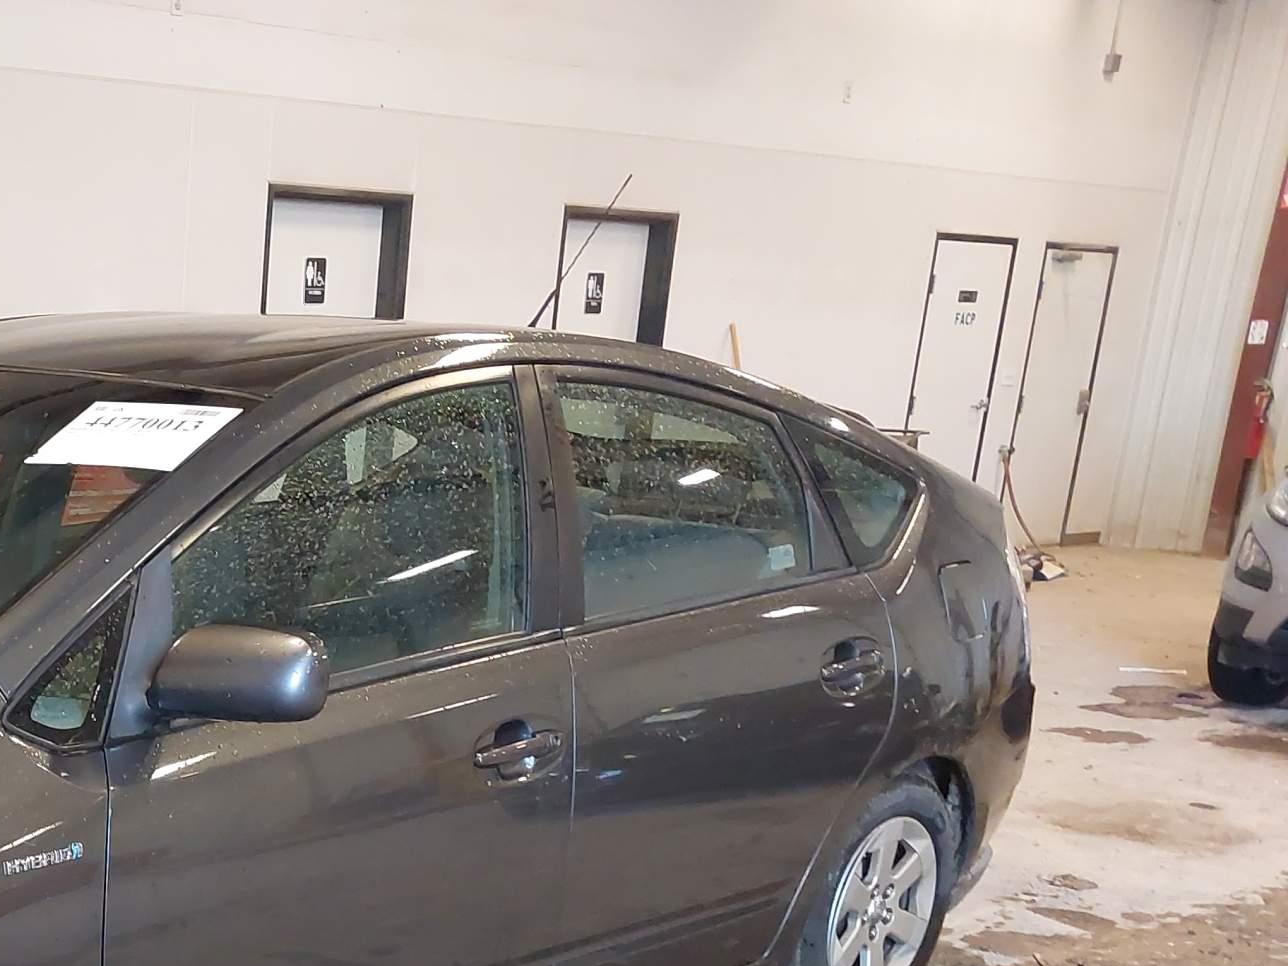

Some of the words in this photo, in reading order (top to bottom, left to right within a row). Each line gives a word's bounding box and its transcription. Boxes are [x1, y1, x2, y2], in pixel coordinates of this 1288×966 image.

[954, 312, 976, 326] FACP
[85, 416, 204, 432] 44770013
[2, 846, 72, 875] HYBRID
